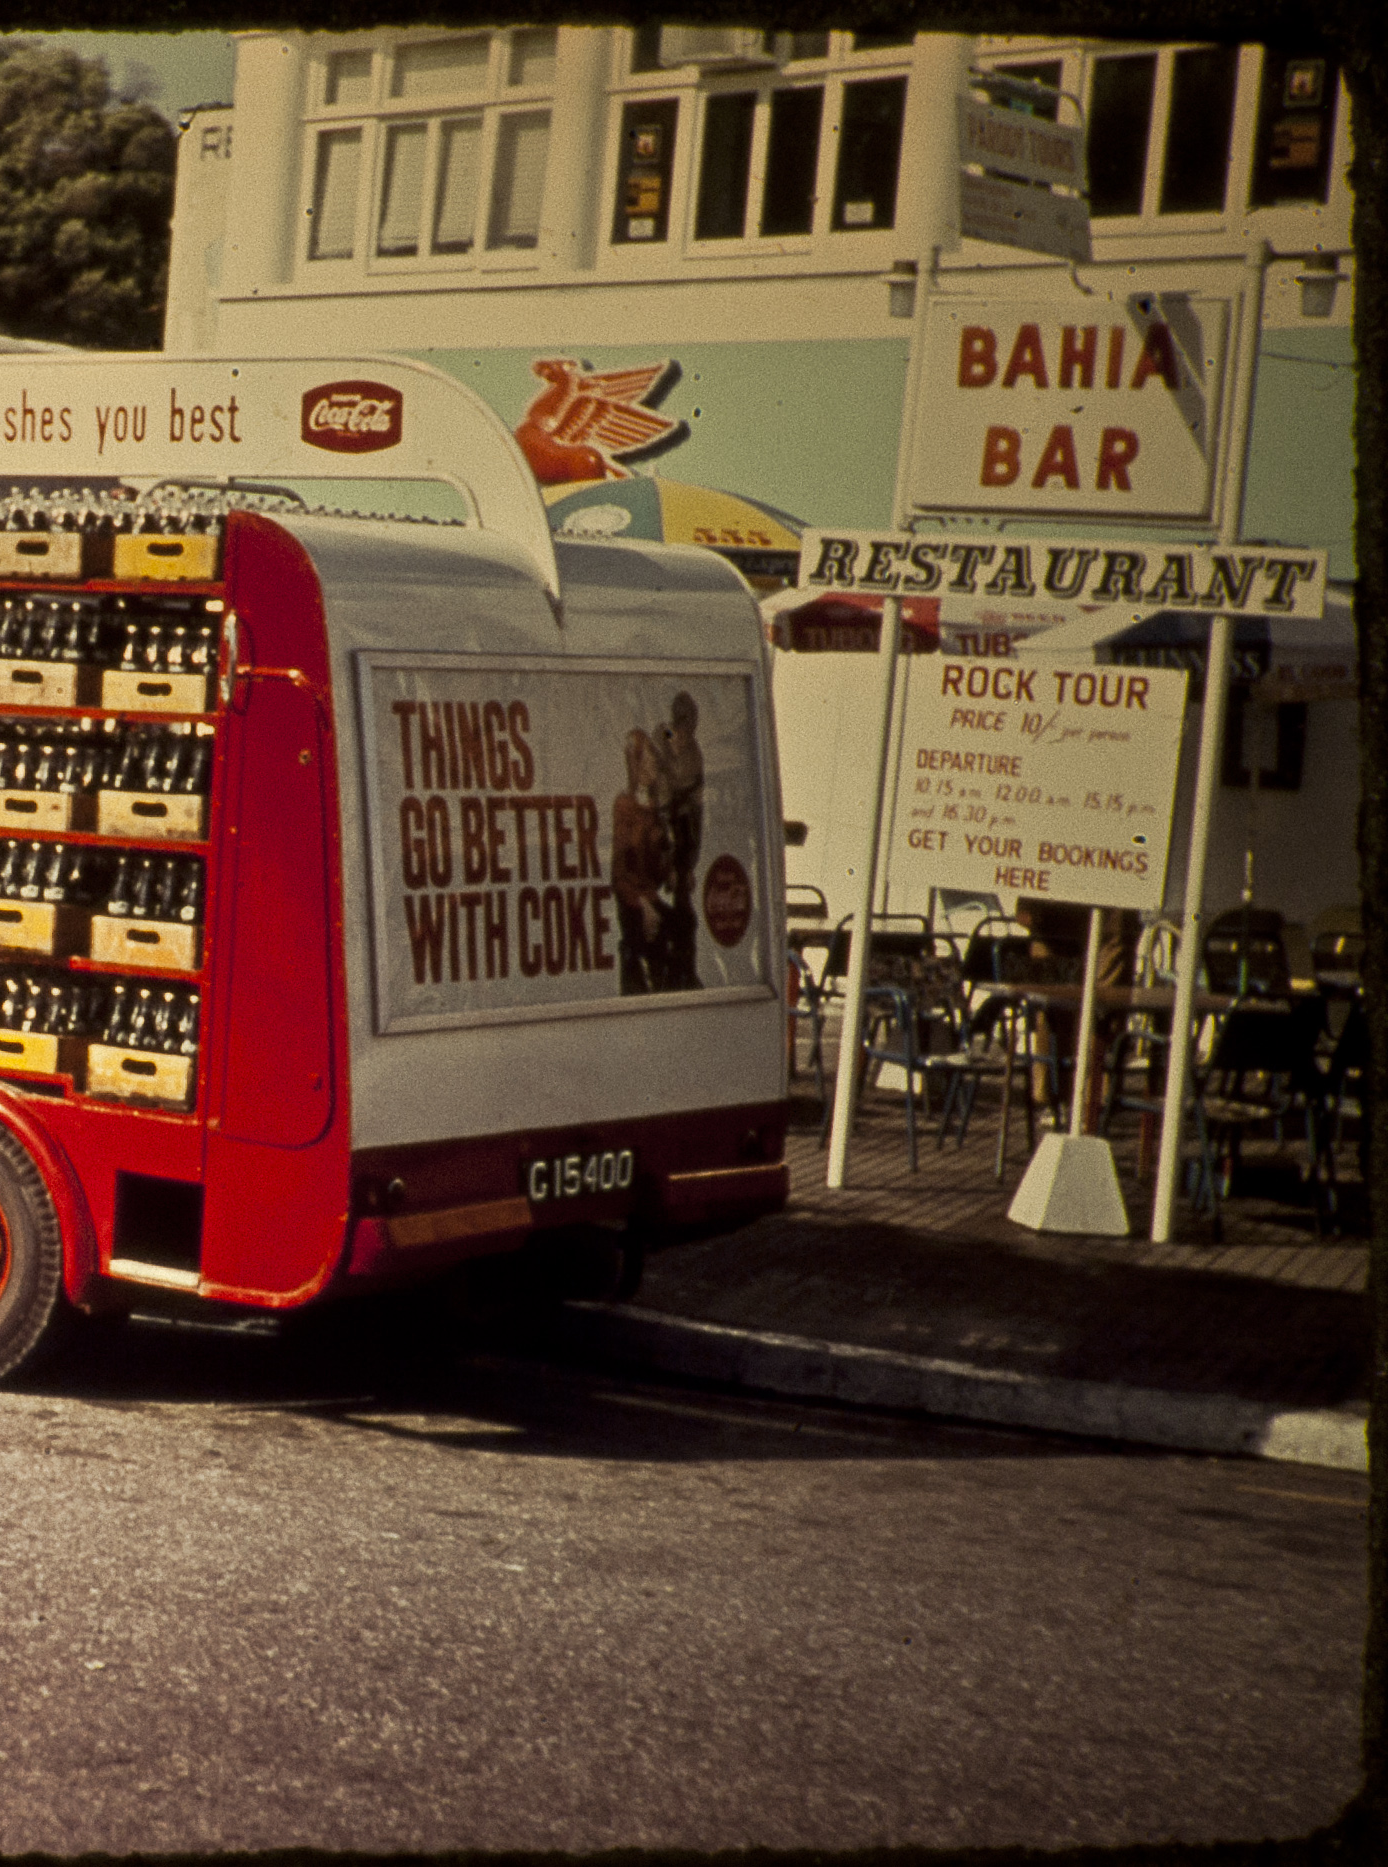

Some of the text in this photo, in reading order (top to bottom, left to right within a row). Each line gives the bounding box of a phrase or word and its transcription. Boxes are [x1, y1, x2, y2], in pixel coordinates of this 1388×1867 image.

[957, 321, 1182, 391] BAHIA
[95, 405, 147, 456] you
[169, 386, 243, 443] best
[309, 398, 395, 433] Coca-Cola
[979, 423, 1140, 492] BAR
[808, 536, 1318, 613] RESTAURANT
[940, 664, 1150, 710] ROCK TOUR
[391, 700, 535, 791] THINGS
[950, 707, 1008, 733] PRICE
[915, 748, 1023, 778] DEPARTURE
[400, 794, 603, 889] GO BETTER
[907, 828, 1149, 874] GET YOUR BOOKINGS
[994, 865, 1052, 892] HERE
[403, 890, 510, 985] WITH
[517, 884, 615, 979] COKE
[529, 1150, 633, 1200] G15400
